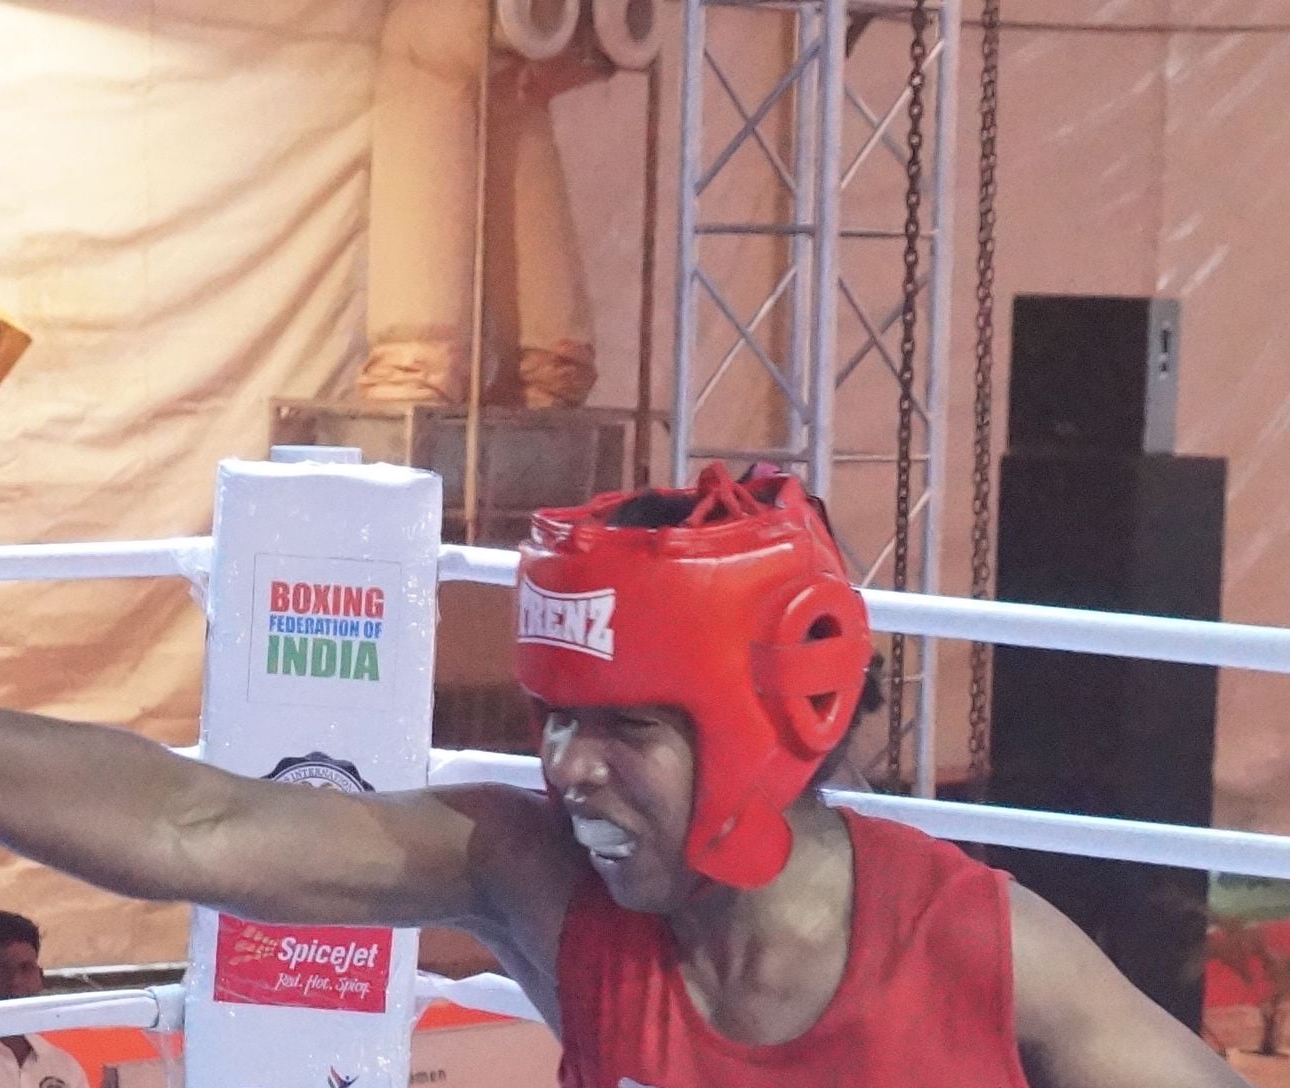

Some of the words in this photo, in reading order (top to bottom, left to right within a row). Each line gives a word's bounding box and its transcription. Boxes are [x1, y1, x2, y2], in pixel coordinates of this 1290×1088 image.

[270, 580, 384, 618] BOXING
[269, 614, 359, 637] FEDERATION
[363, 620, 382, 638] OF
[267, 634, 380, 681] INDIA
[277, 937, 378, 973] SpiceJet
